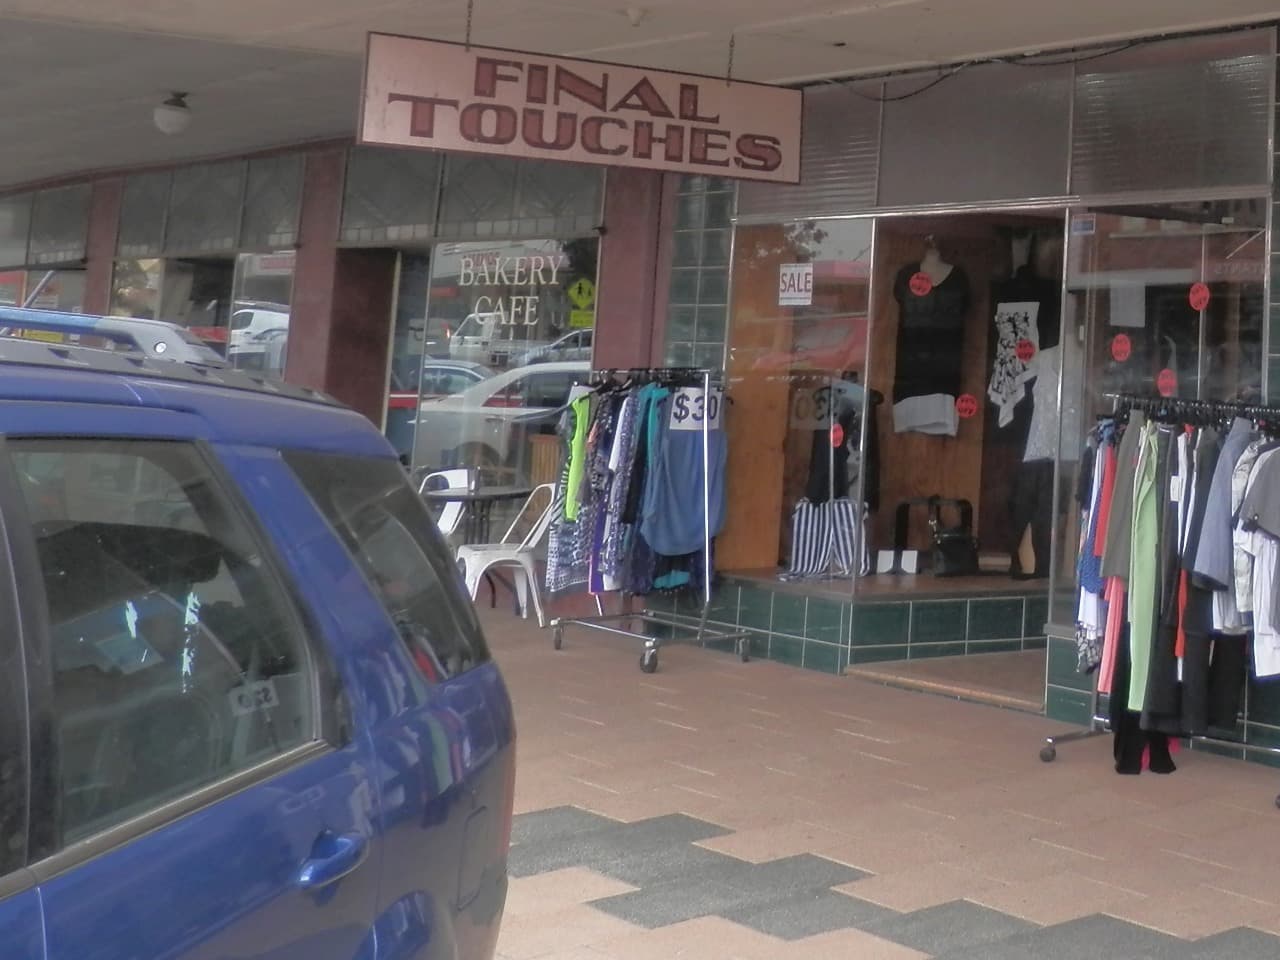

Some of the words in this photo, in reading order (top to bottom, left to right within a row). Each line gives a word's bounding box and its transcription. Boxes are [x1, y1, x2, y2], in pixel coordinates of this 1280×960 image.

[474, 56, 720, 125] FINAL
[388, 93, 783, 172] TOUCHES
[458, 255, 563, 286] BAKERY
[780, 272, 812, 292] SALE
[474, 295, 539, 325] CAFE
[673, 393, 718, 423] $30
